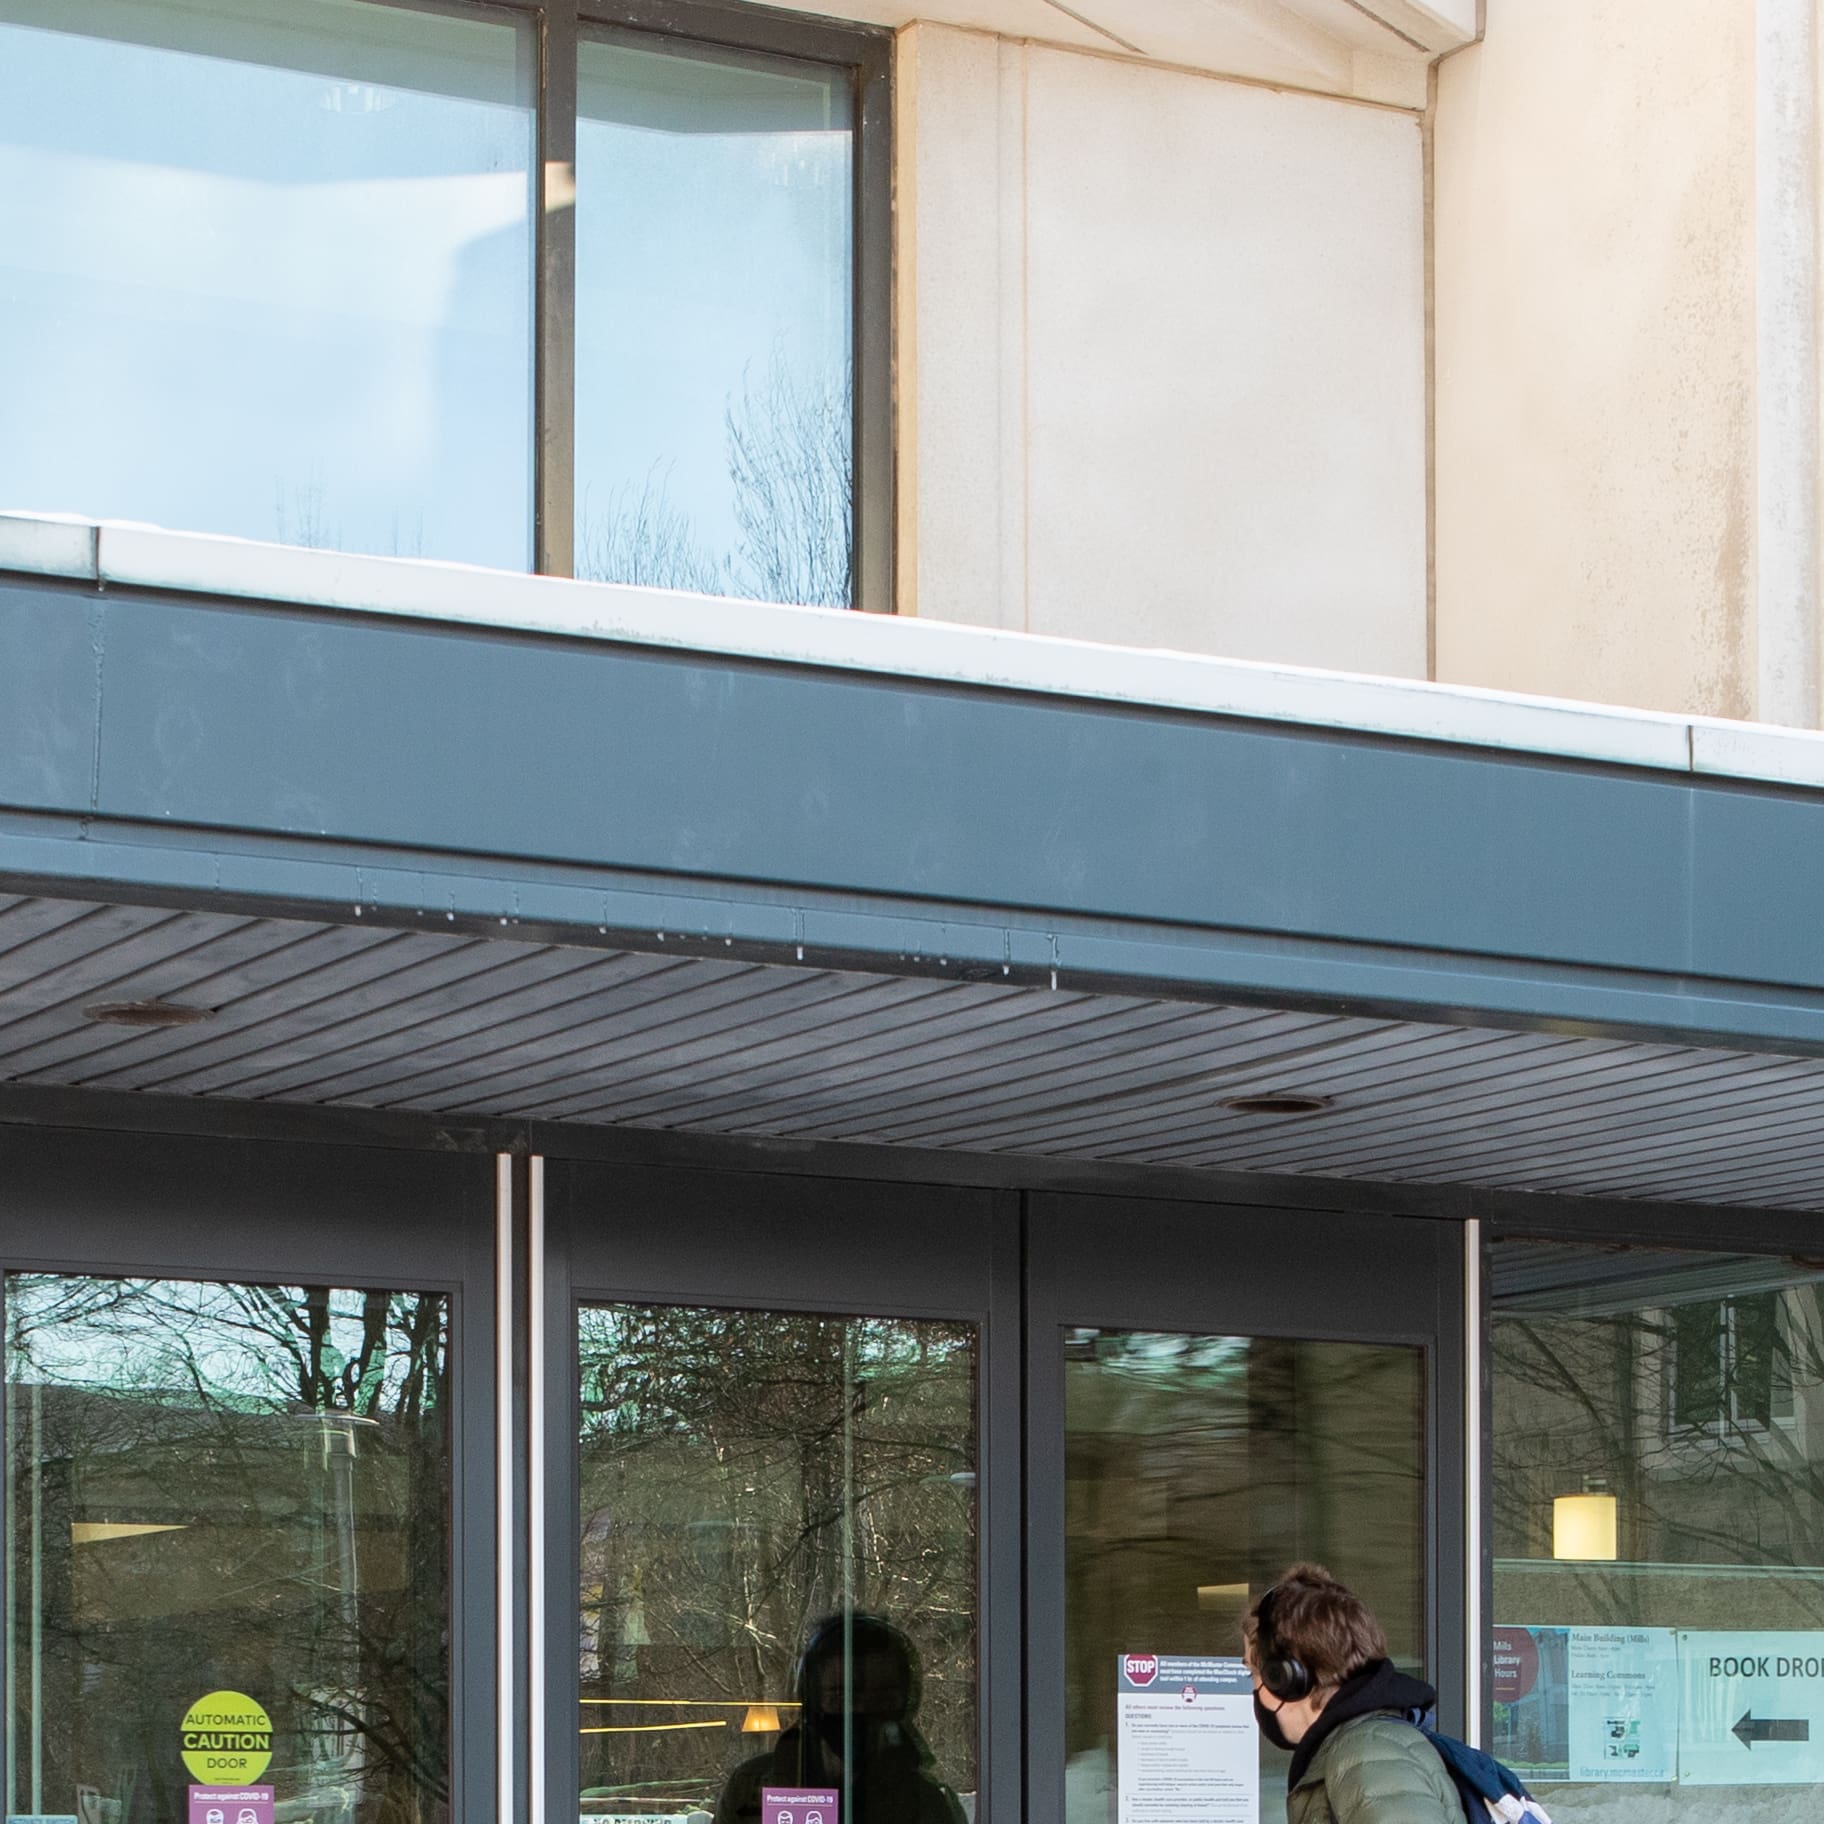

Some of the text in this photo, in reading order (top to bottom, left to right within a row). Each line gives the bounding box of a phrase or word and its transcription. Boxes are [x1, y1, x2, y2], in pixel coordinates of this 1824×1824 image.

[1493, 1640, 1512, 1651] Mills
[1127, 1660, 1155, 1673] STOP
[1493, 1654, 1521, 1667] Library
[1494, 1668, 1517, 1679] Hours
[1709, 1657, 1770, 1678] BOOK
[1571, 1670, 1646, 1681] Learning Commons
[186, 1713, 266, 1726] AUTOMATIC
[183, 1733, 270, 1749] CAUTION
[207, 1758, 248, 1769] DOOR
